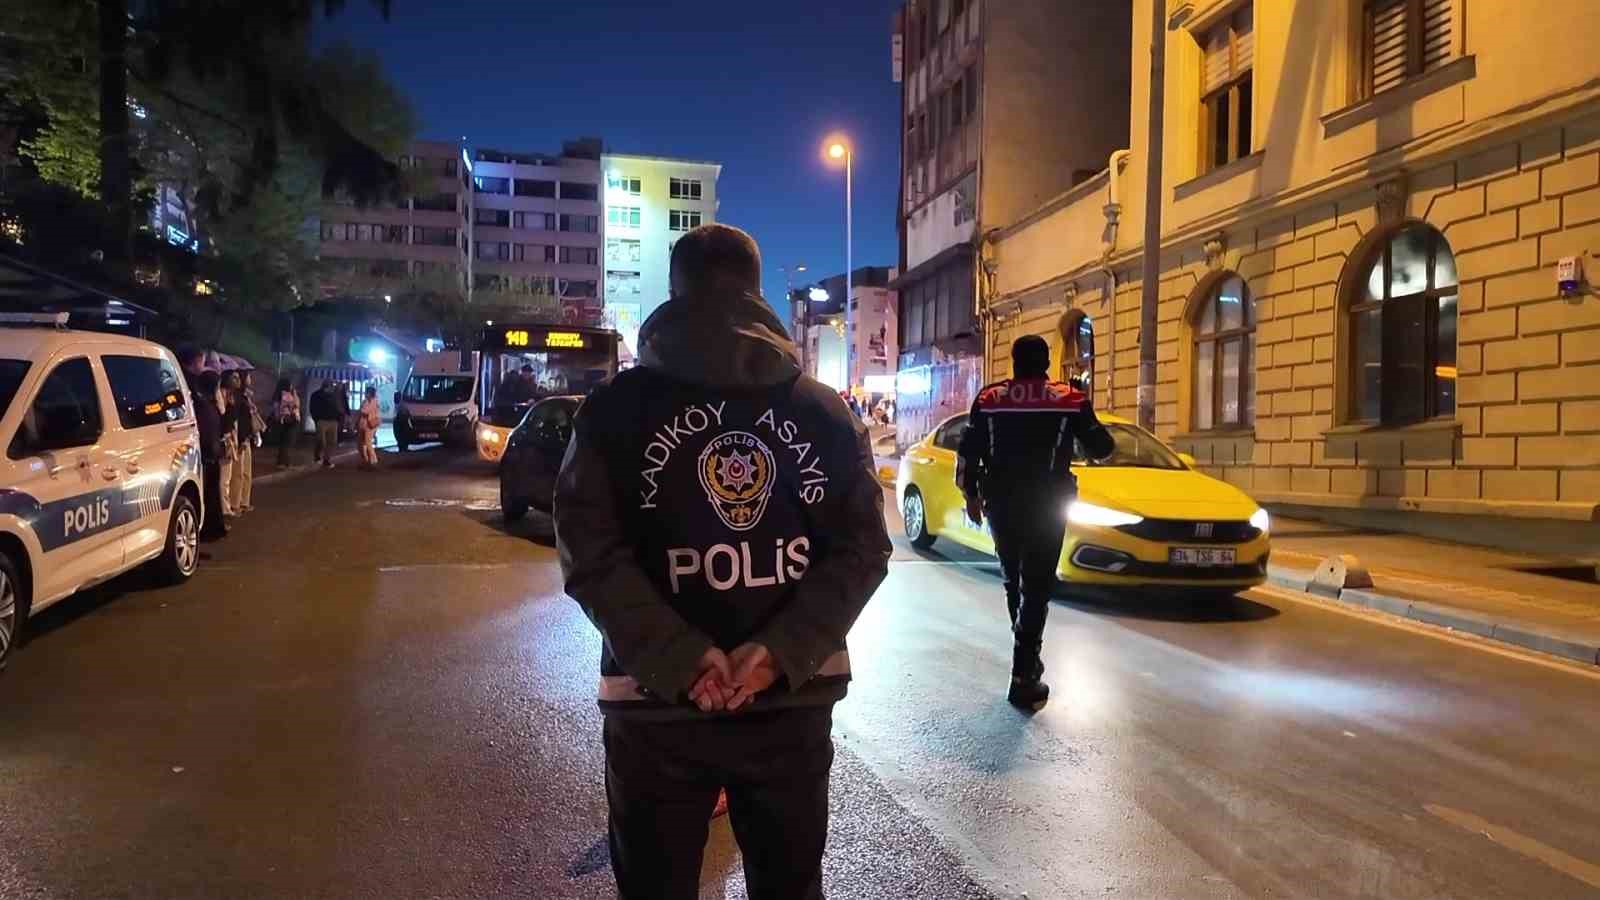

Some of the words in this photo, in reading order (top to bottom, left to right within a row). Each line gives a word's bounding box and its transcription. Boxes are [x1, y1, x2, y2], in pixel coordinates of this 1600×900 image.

[640, 401, 726, 509] KADIKÖY
[755, 408, 829, 504] ASAYİŞ
[64, 496, 109, 537] POLİS
[667, 536, 811, 594] POLİS
